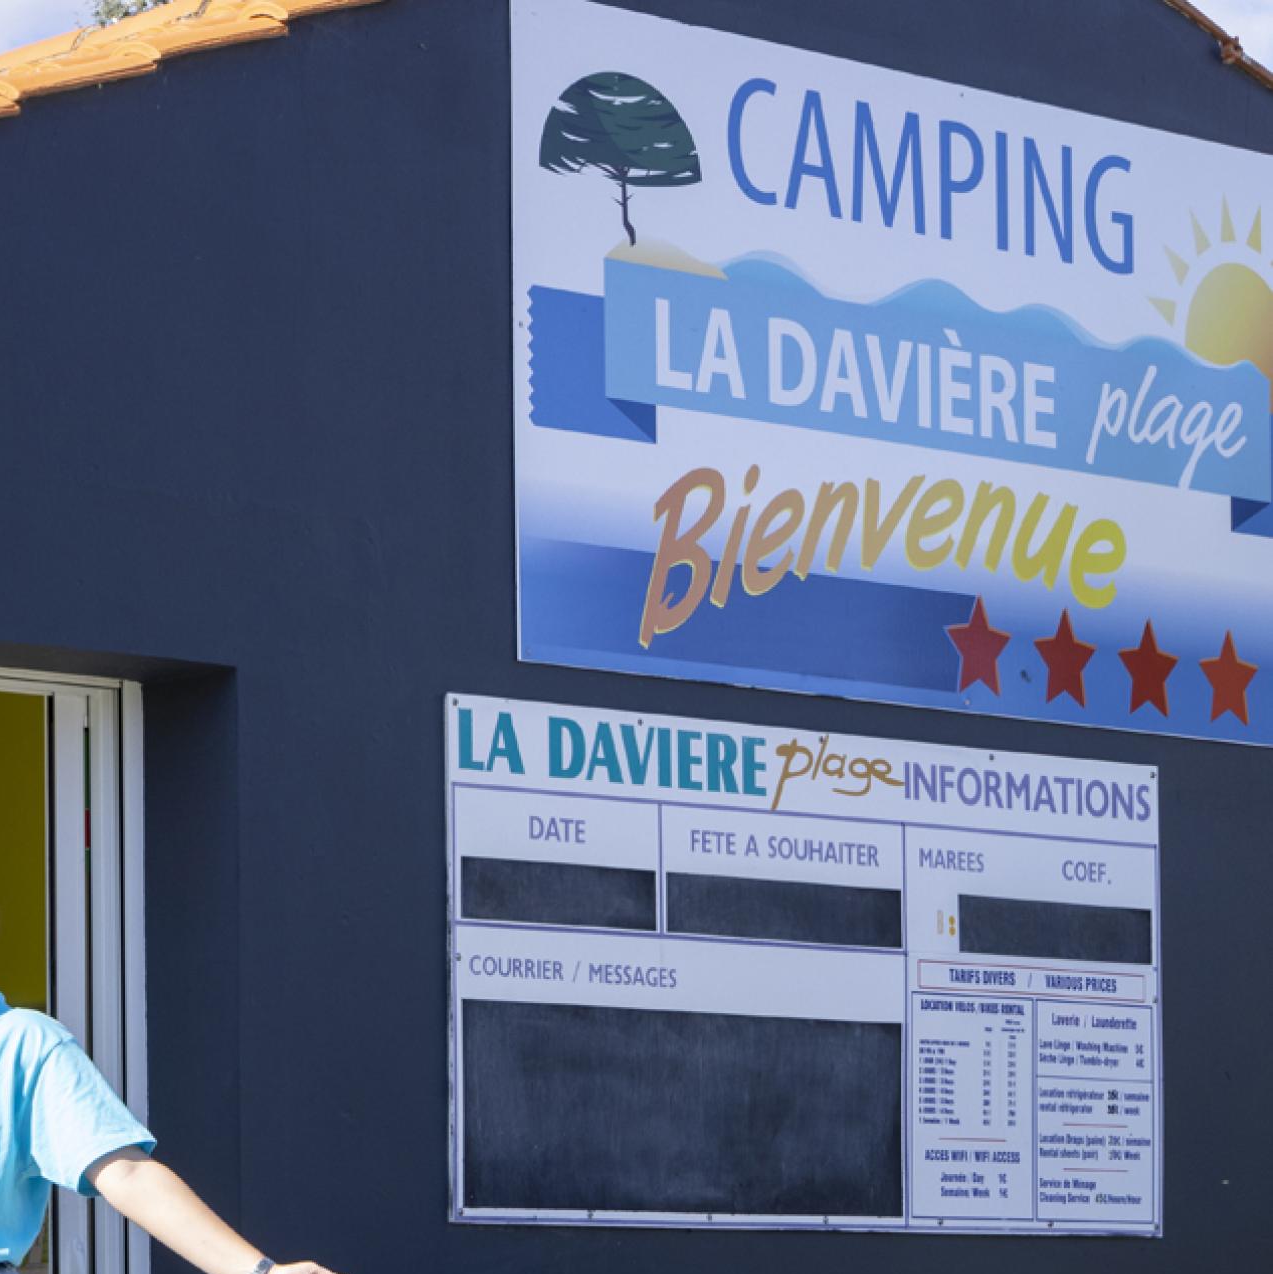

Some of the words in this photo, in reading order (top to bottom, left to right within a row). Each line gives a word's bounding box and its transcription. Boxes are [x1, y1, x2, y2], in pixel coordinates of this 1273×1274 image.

[727, 77, 1134, 275] CAMPING
[655, 296, 746, 399] LA
[768, 317, 1057, 449] DAVIÈRE
[1085, 364, 1248, 490] plage
[639, 464, 1128, 649] Bienvenue
[458, 707, 526, 774] LA
[548, 716, 767, 797] DAVIERE
[775, 734, 905, 812] plage
[904, 761, 1152, 822] INFORMATIONS
[528, 815, 587, 844] DATE
[690, 829, 736, 856] FETE
[744, 834, 760, 858] A
[767, 835, 880, 868] SOUHAITER
[918, 847, 985, 873] MAREES
[1061, 859, 1112, 885] COEF.
[469, 954, 565, 982] COURRIER
[572, 960, 582, 983] /
[588, 962, 678, 989] MESSAGES
[948, 968, 980, 984] TARIFS
[983, 970, 1016, 986] DIVERS
[1045, 974, 1083, 992] VARIOUS
[1085, 976, 1117, 993] PRICES
